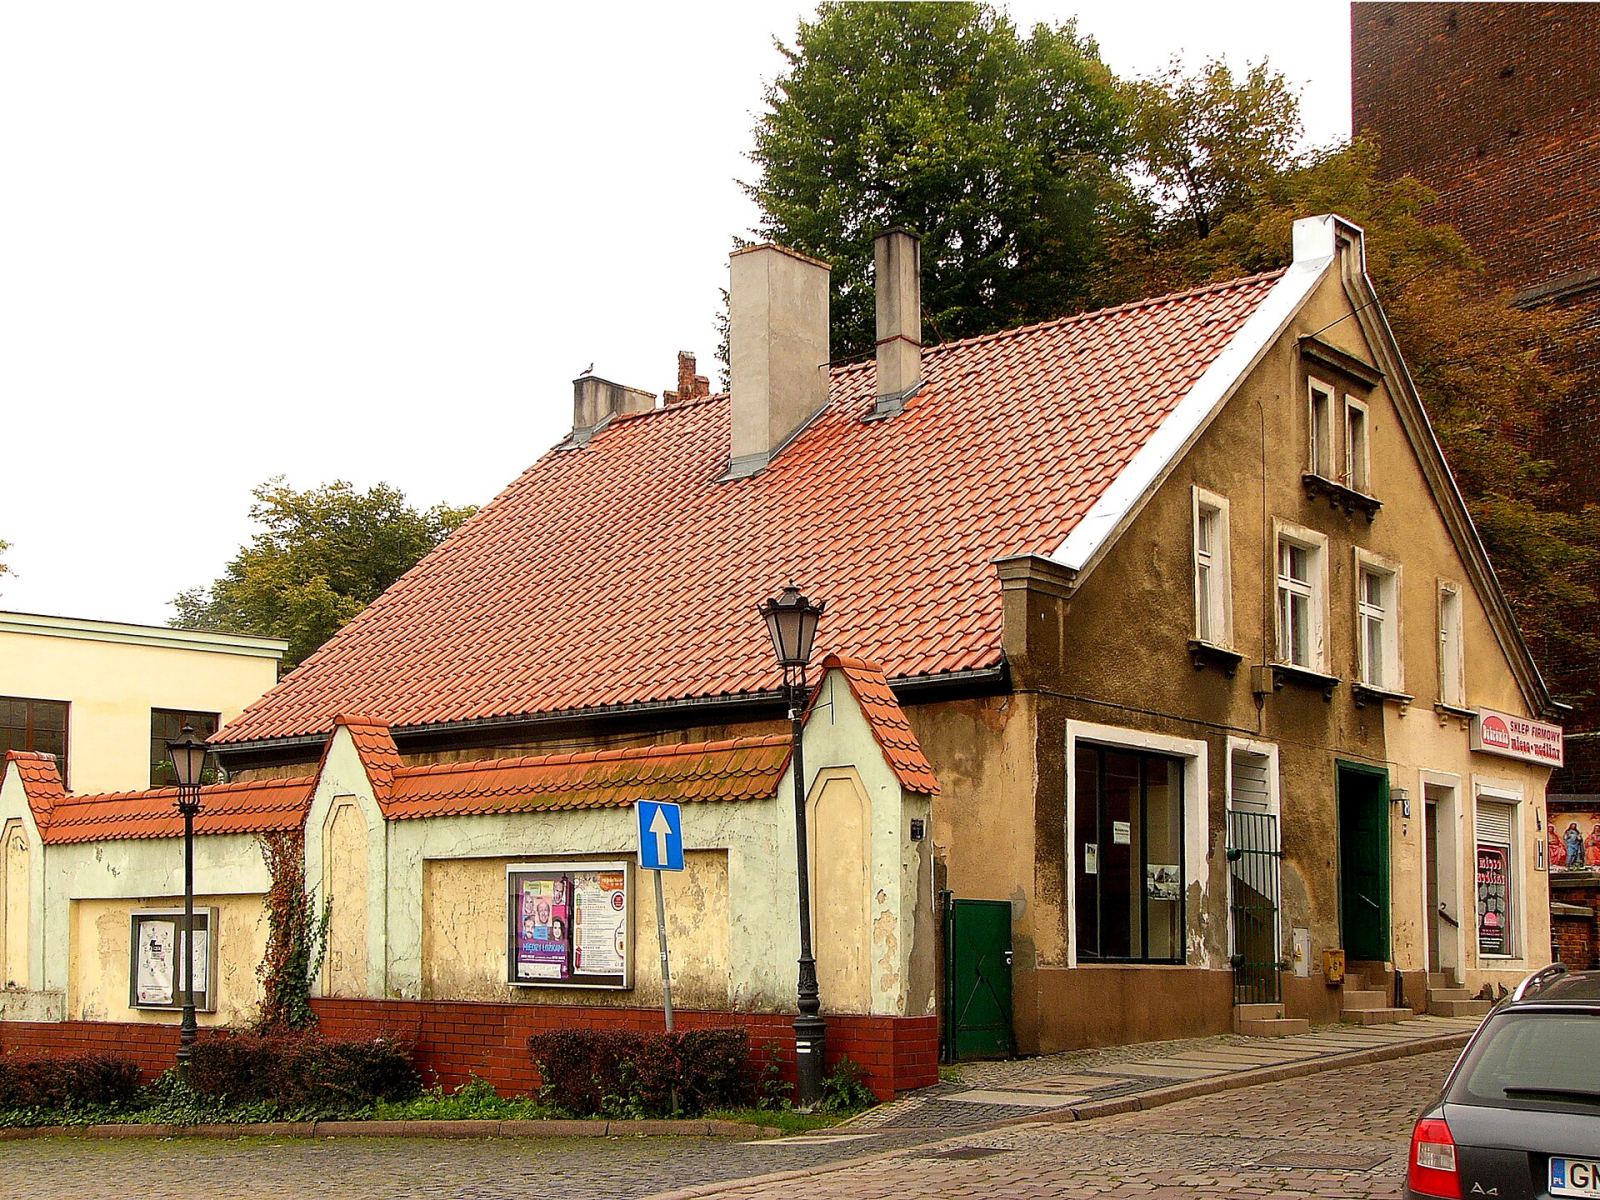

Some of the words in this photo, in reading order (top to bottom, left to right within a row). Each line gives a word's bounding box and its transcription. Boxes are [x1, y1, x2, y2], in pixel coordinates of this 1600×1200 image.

[1510, 721, 1530, 734] SKLEP
[1532, 726, 1561, 743] FIRMOWY
[1470, 1181, 1498, 1196] A4
[1553, 1177, 1563, 1185] PL
